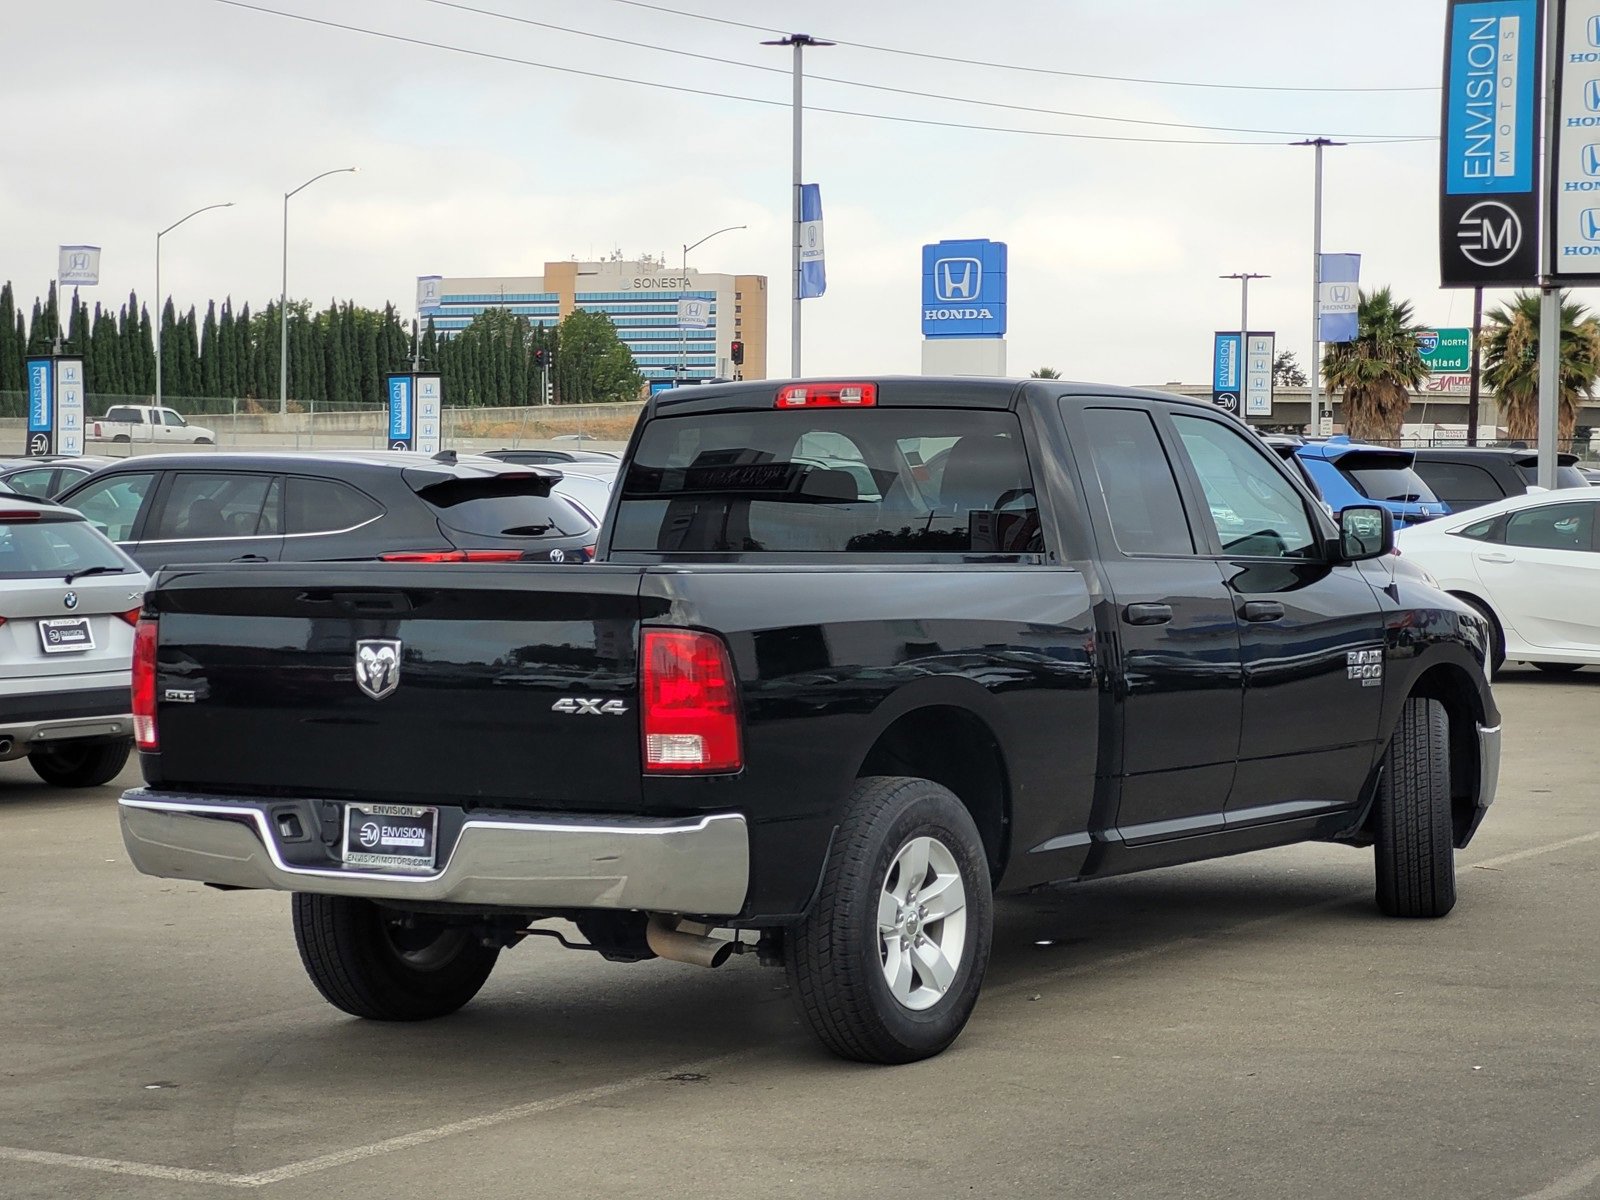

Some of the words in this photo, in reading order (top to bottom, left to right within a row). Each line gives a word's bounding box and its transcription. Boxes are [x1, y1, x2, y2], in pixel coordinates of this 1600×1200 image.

[1464, 16, 1497, 178] ENVISION
[1499, 31, 1515, 163] MOTORS
[633, 277, 692, 289] SONESTA
[924, 308, 994, 320] HONDA
[1219, 339, 1230, 387] ENVISION
[33, 366, 42, 426] ENVISION
[1347, 650, 1382, 665] RAM
[1347, 664, 1382, 680] 1500
[551, 697, 630, 716] 4X4
[372, 805, 413, 816] ENVISION
[381, 826, 426, 839] ENVISION
